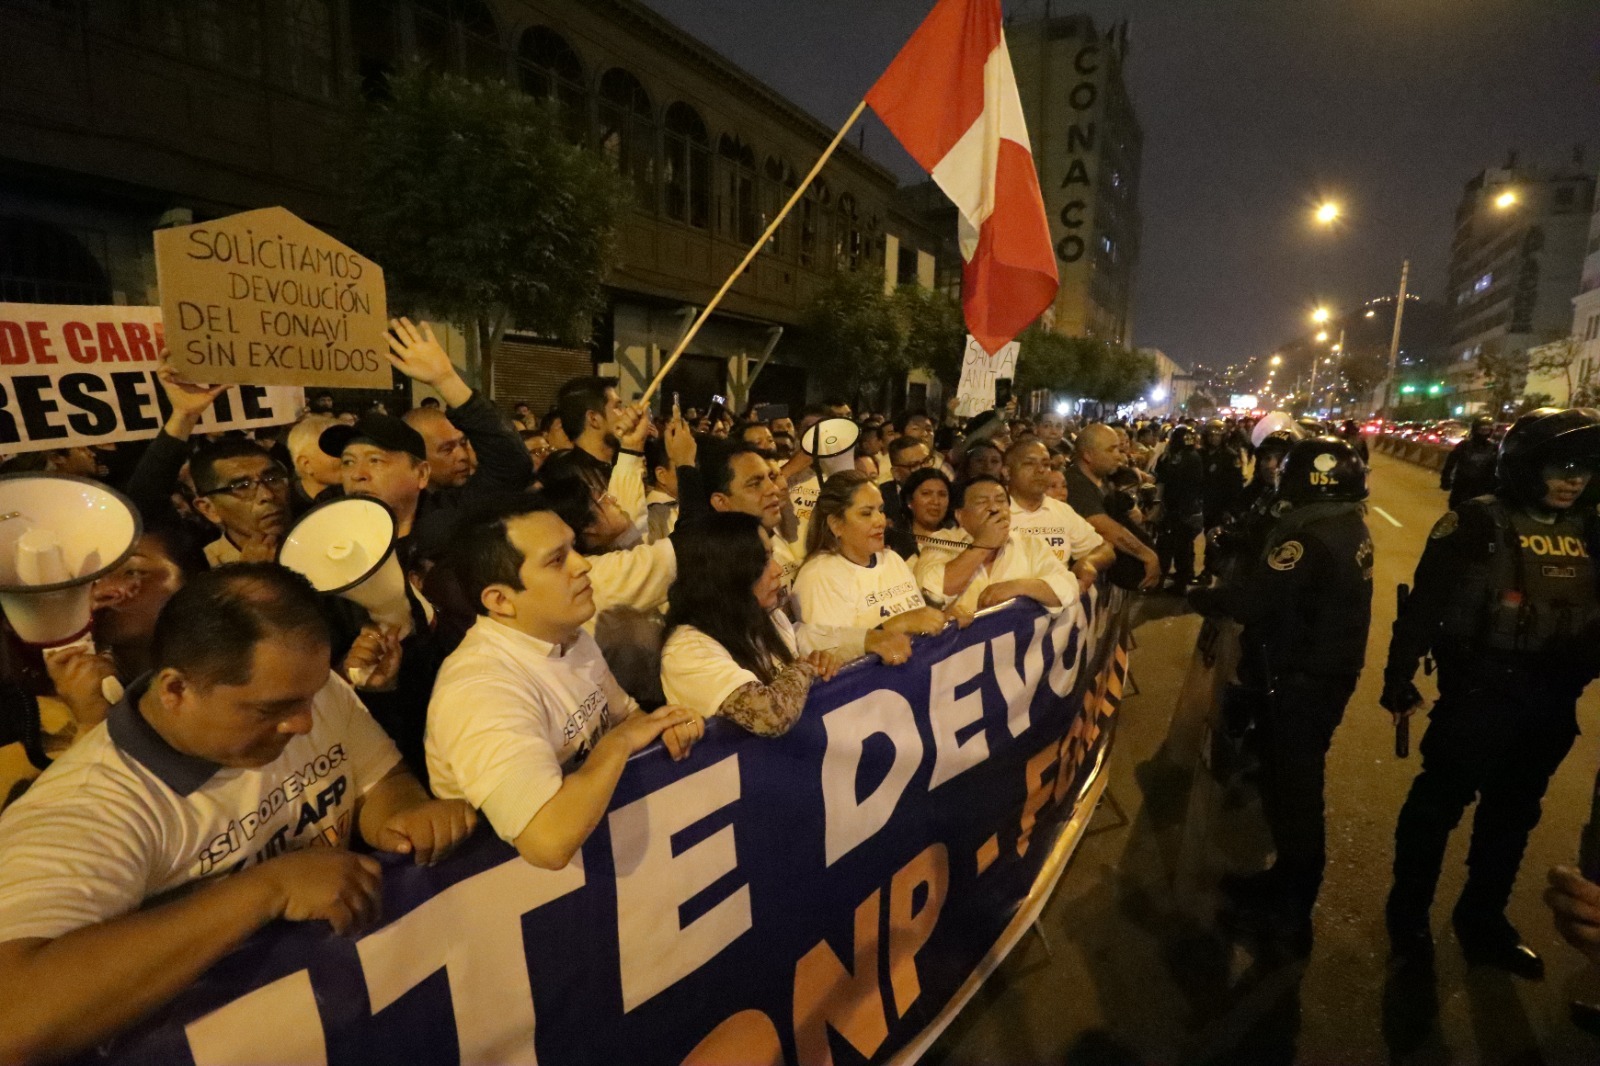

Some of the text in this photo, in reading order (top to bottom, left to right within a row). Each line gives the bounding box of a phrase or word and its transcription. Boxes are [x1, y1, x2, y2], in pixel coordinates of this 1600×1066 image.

[1057, 46, 1099, 263] CONACO
[178, 301, 240, 334] DEL
[0, 320, 58, 366] DE
[186, 334, 237, 367] SIN
[1519, 534, 1589, 558] POLICI
[880, 605, 890, 618] 4
[293, 774, 347, 838] AFP
